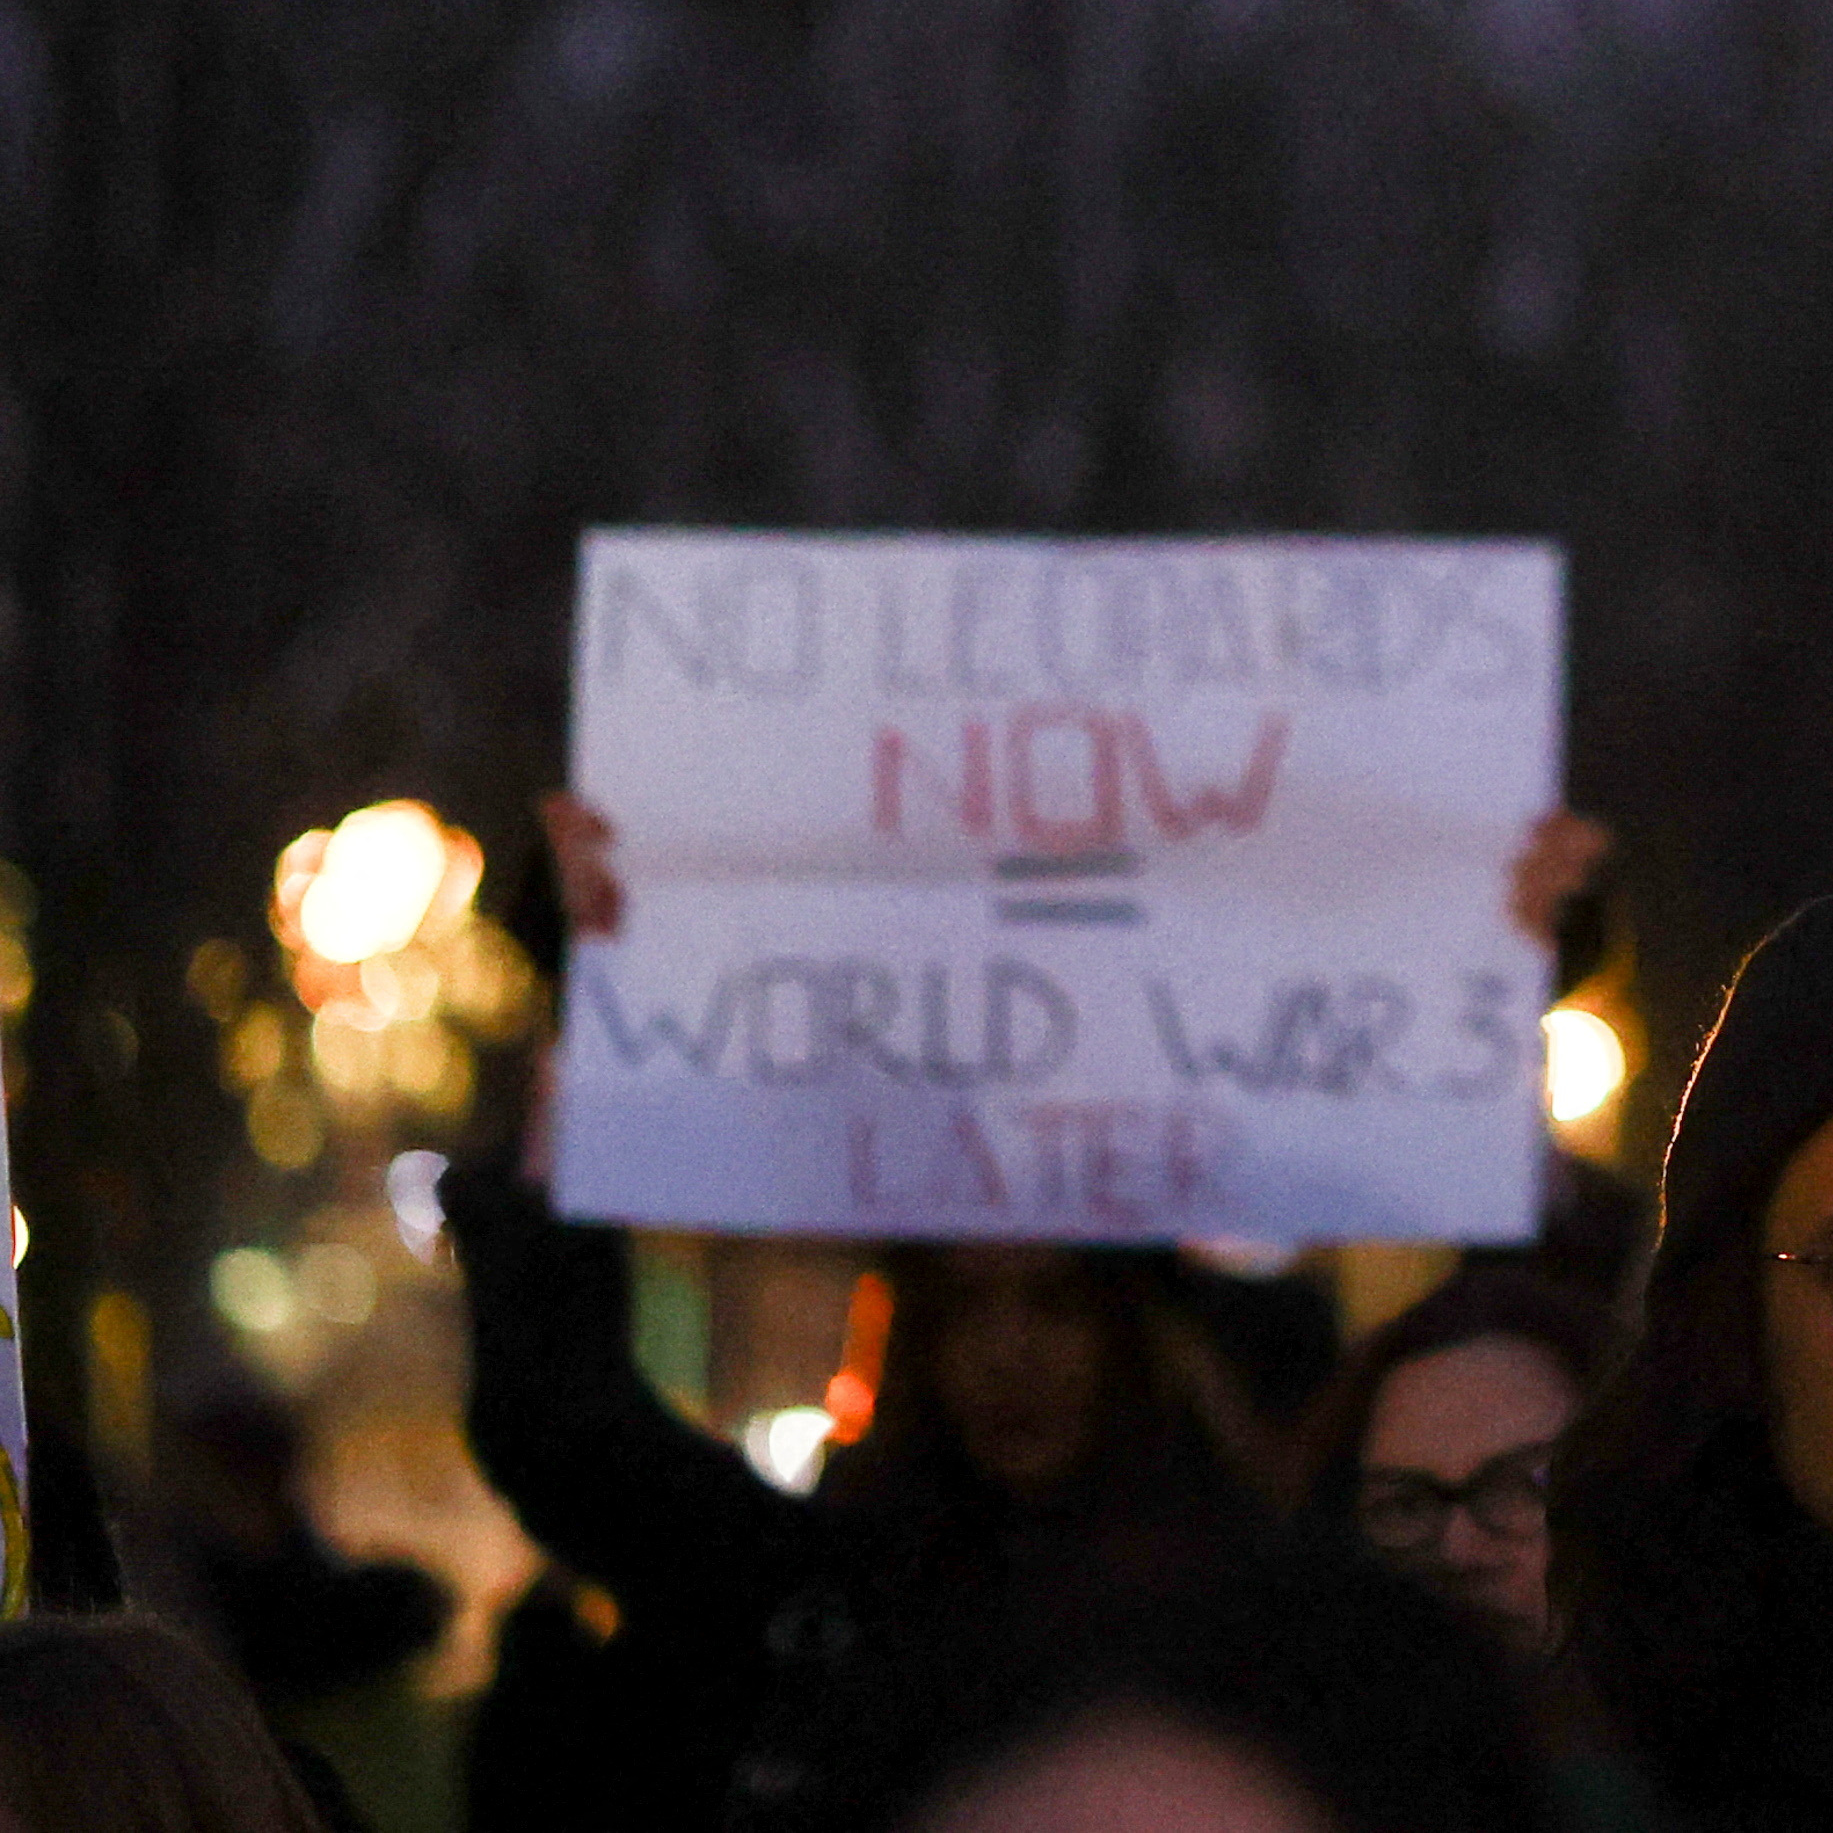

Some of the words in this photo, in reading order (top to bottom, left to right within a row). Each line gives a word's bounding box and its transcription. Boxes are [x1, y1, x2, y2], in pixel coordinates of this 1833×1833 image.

[603, 558, 824, 700] NO
[868, 698, 1291, 856] NOW
[590, 954, 1080, 1090] WORLD
[1436, 969, 1523, 1100] 3
[846, 1098, 1232, 1222] LATER
